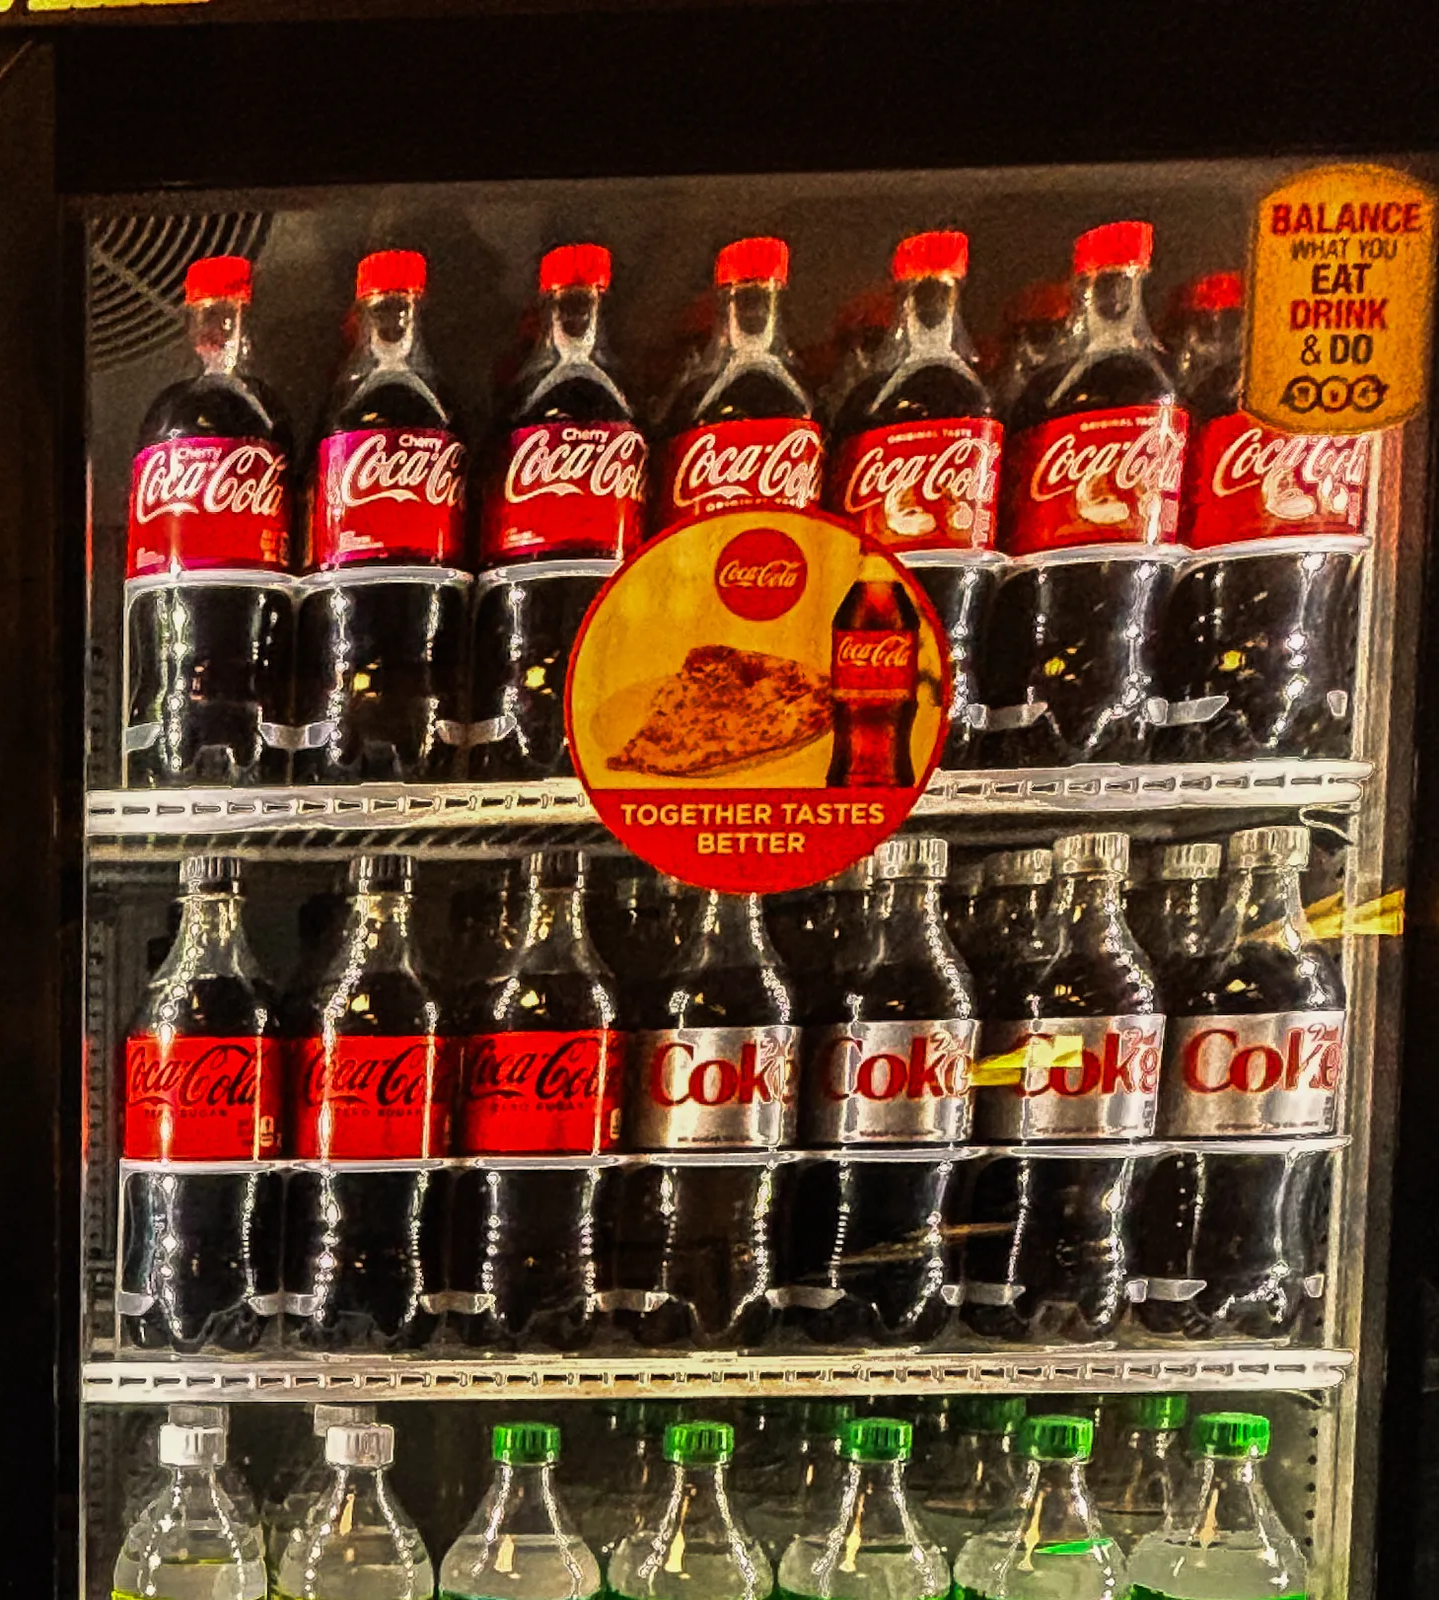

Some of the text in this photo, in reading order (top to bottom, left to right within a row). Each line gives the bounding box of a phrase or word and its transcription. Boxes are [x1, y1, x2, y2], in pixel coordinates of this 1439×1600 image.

[1270, 201, 1423, 235] BALANCE
[1290, 238, 1398, 260] WHAT YOU
[1311, 263, 1373, 295] EAT
[1290, 299, 1389, 330] DRINK
[1300, 334, 1374, 366] & DO
[399, 434, 443, 450] Cherry
[561, 428, 611, 445] Cherry
[718, 559, 803, 588] Coca-Cola
[837, 635, 914, 668] Coca-Cola
[621, 803, 885, 827] TOGETHER TASTES
[697, 832, 806, 854] BETTER
